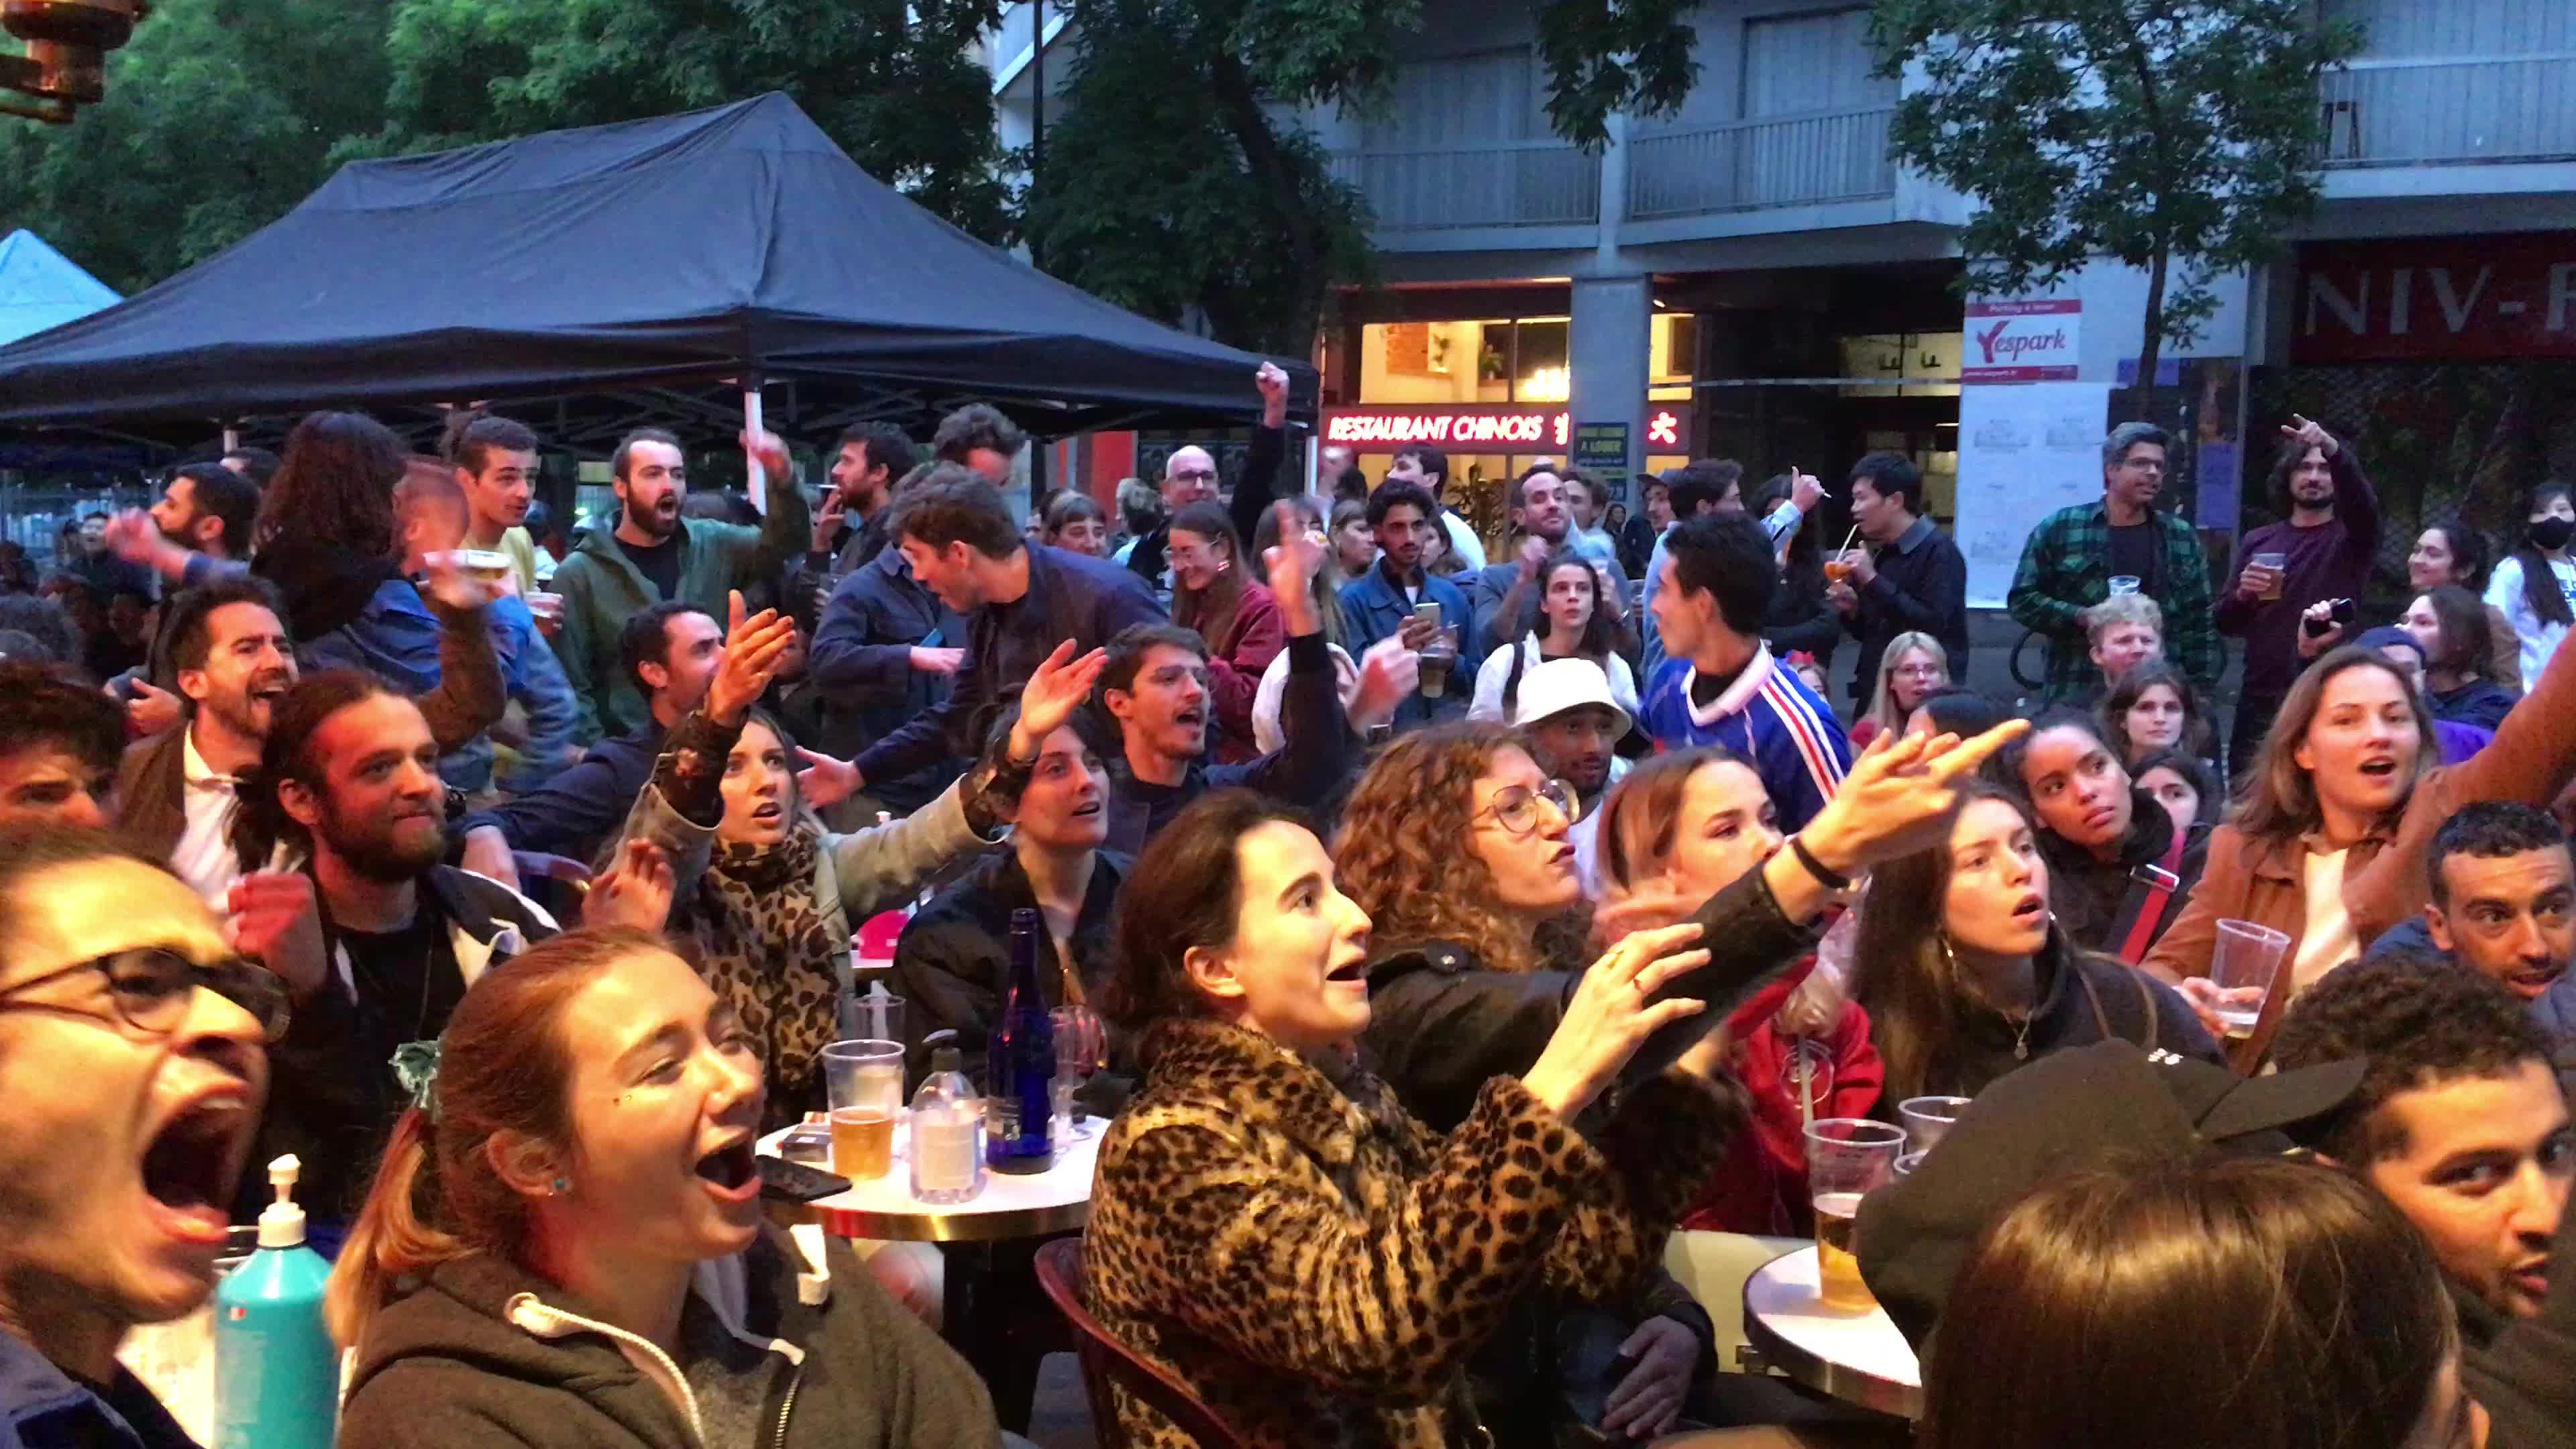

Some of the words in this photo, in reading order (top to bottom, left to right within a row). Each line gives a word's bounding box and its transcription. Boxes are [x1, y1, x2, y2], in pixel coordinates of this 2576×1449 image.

[1976, 320, 2066, 364] Yespark
[1328, 416, 1454, 440] RESTAURANT
[1453, 415, 1544, 441] CHINOIS
